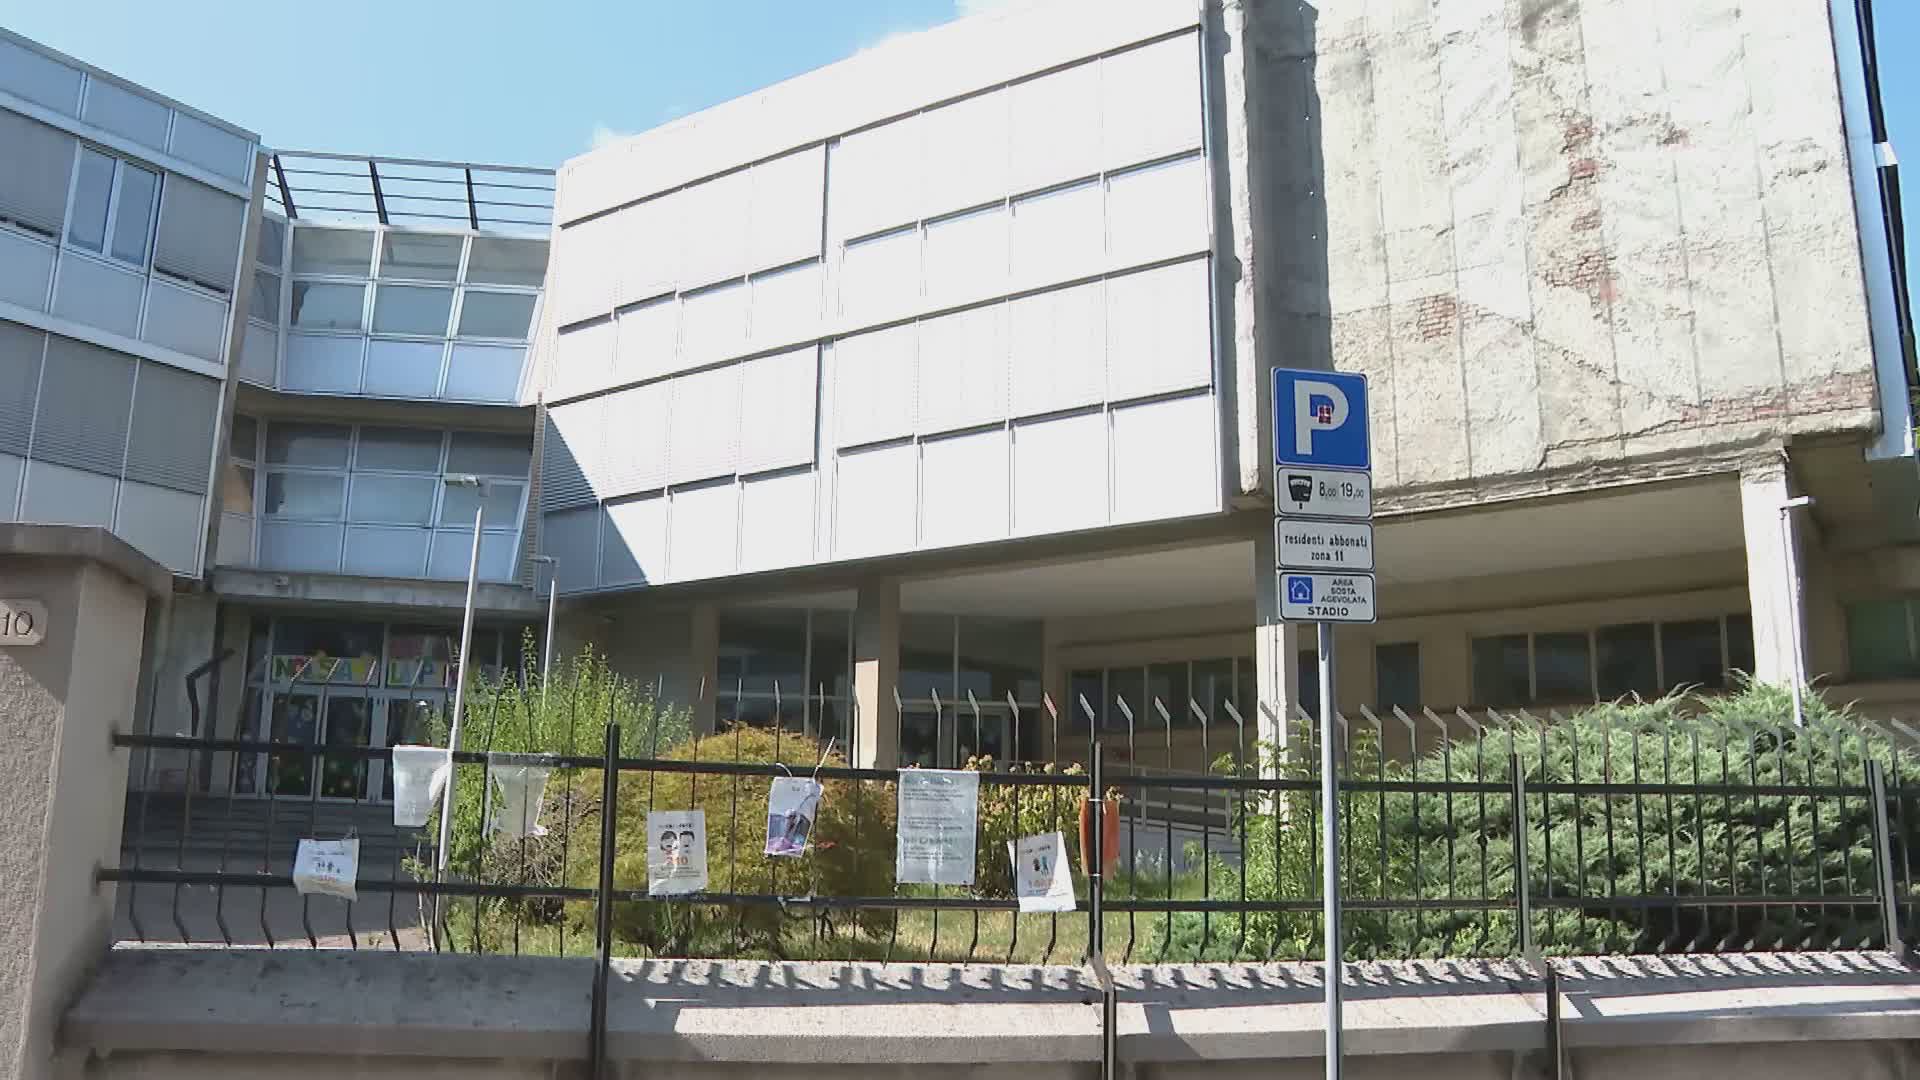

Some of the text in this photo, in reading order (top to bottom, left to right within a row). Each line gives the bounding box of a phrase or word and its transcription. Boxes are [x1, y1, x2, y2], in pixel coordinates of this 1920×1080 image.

[1294, 379, 1349, 455] P
[1285, 533, 1368, 548] residenti abbonati
[1311, 550, 1344, 561] zona 11
[1331, 587, 1356, 595] SOSTA
[1320, 595, 1367, 604] AGEVOLATA
[1307, 606, 1349, 616] STADIO
